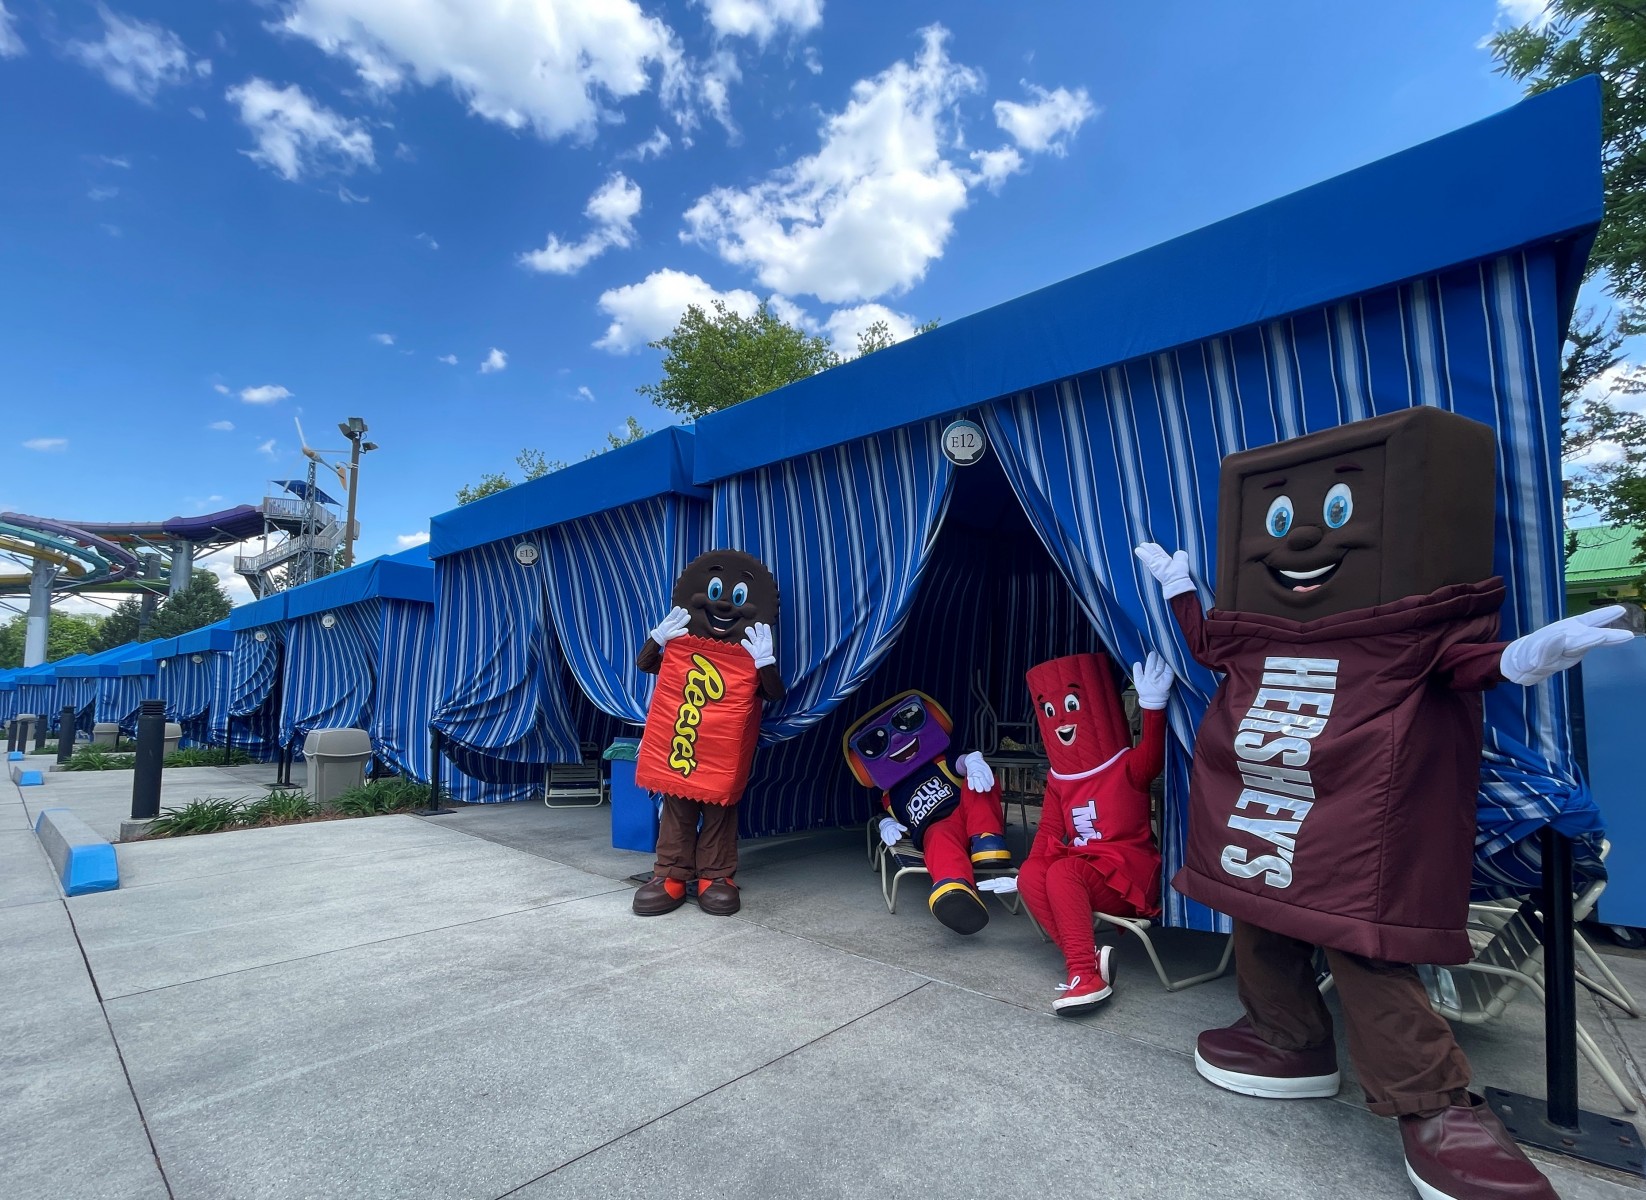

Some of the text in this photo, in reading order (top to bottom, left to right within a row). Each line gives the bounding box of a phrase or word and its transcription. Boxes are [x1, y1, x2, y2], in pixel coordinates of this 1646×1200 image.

[951, 433, 975, 448] E12
[669, 653, 726, 777] Reese's
[907, 778, 941, 821] JOLLY
[1220, 656, 1340, 889] HERSHEY'S
